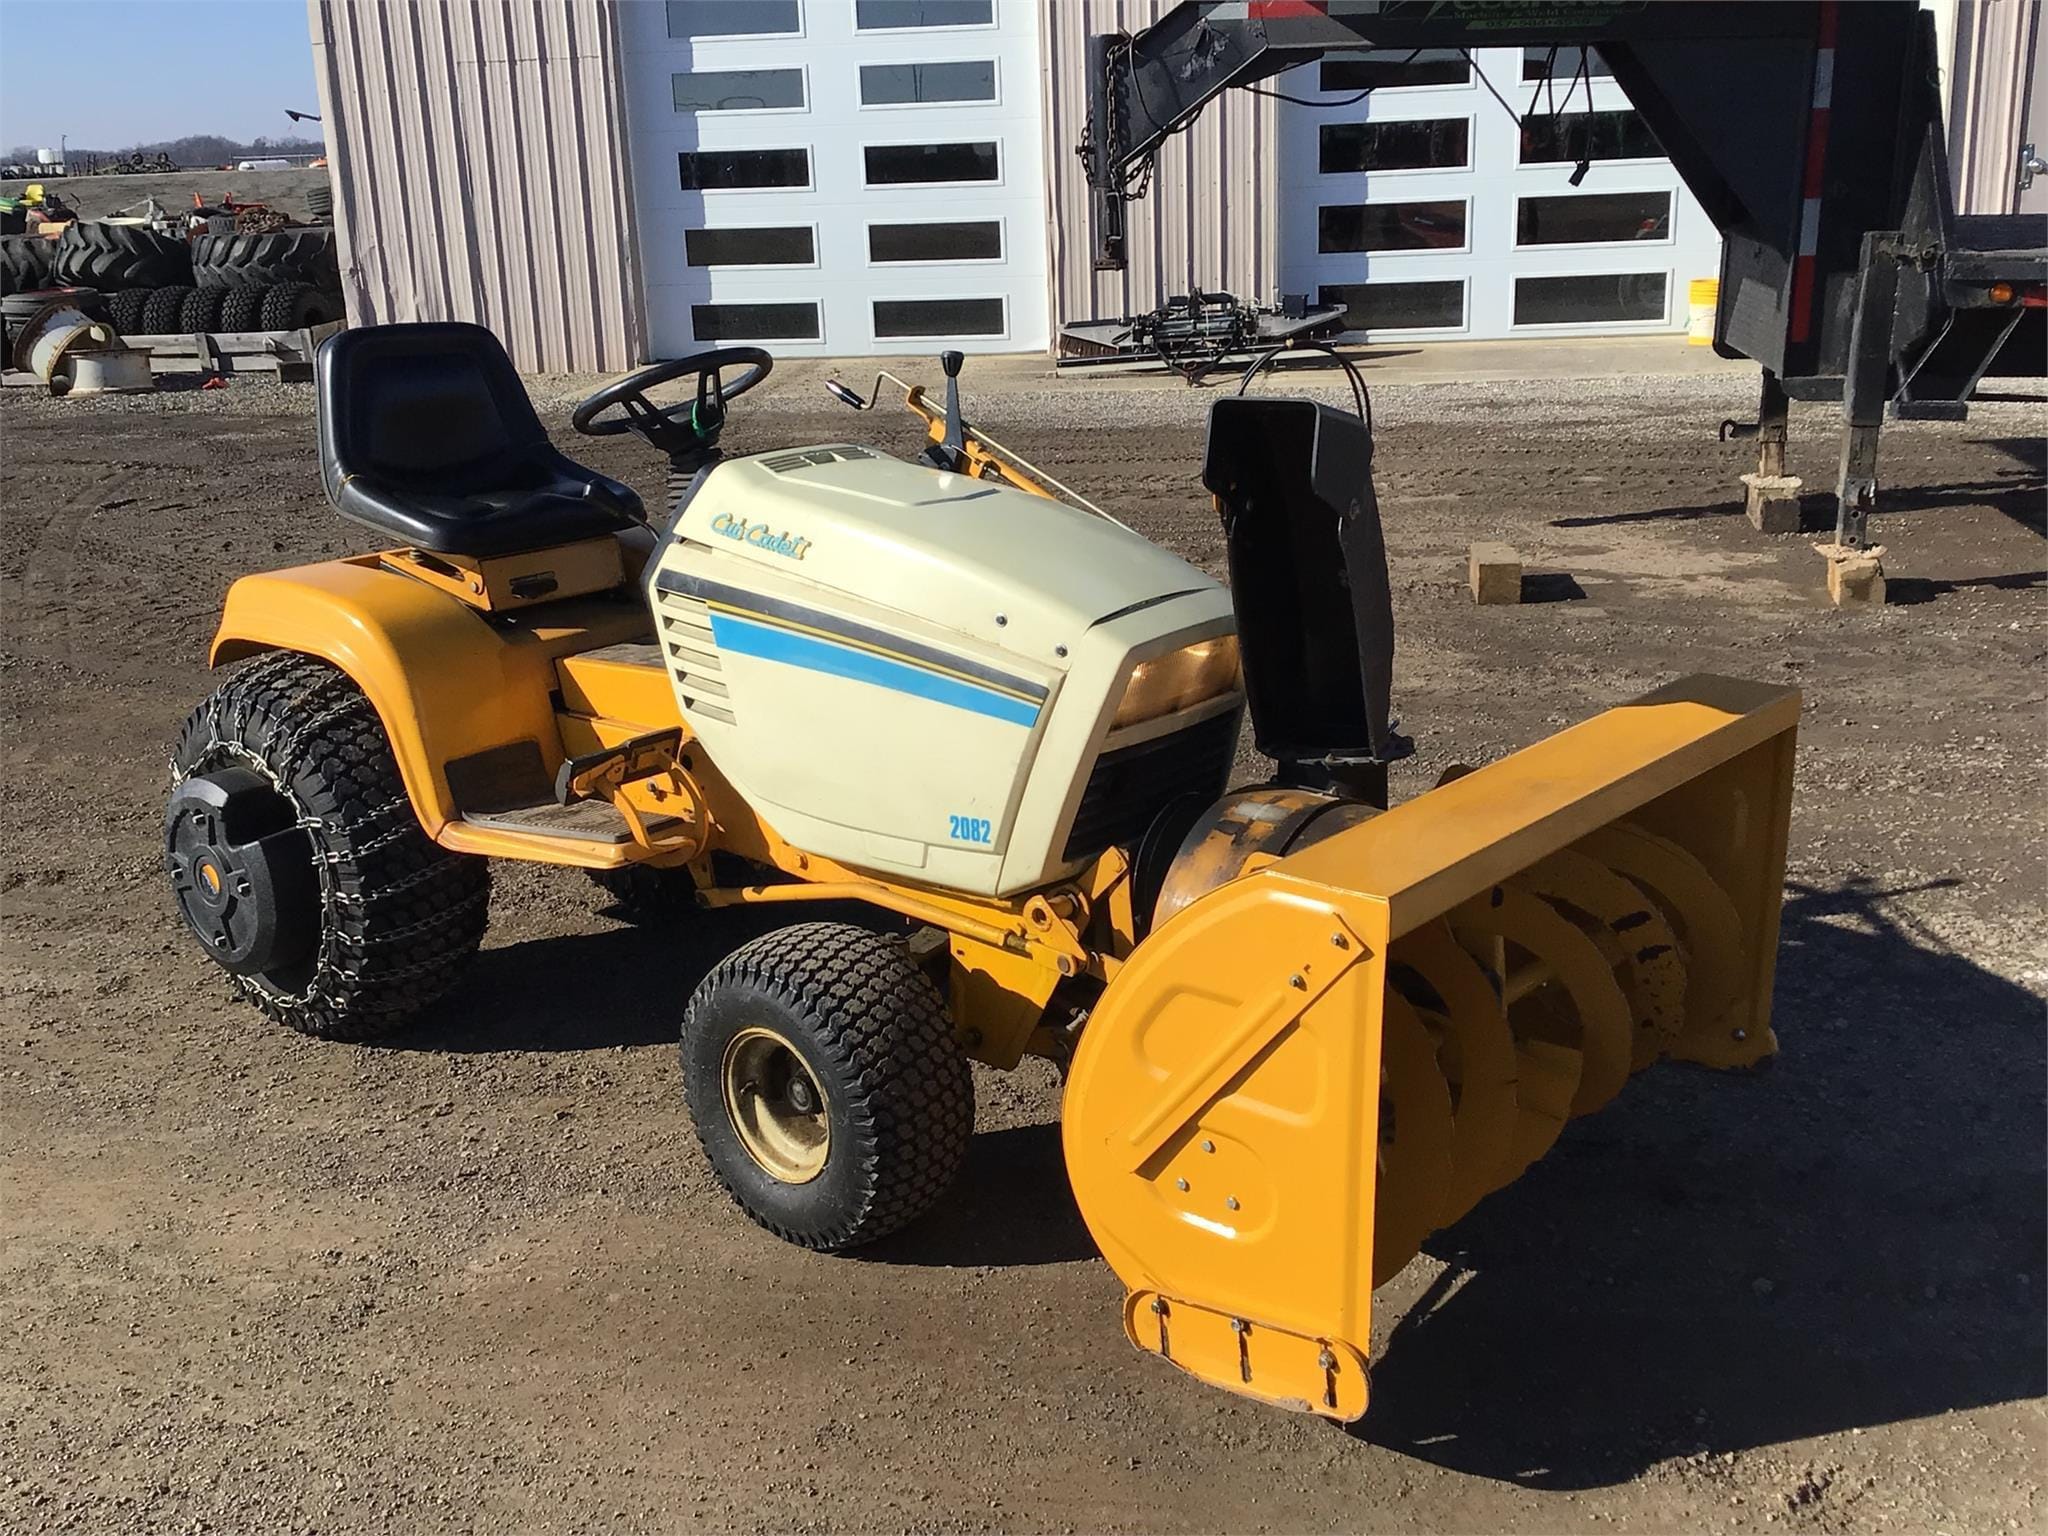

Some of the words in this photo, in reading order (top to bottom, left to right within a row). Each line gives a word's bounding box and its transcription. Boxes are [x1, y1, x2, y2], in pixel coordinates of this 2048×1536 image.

[711, 513, 748, 542] Cub
[743, 523, 813, 561] Cadet
[950, 815, 991, 844] 2082
